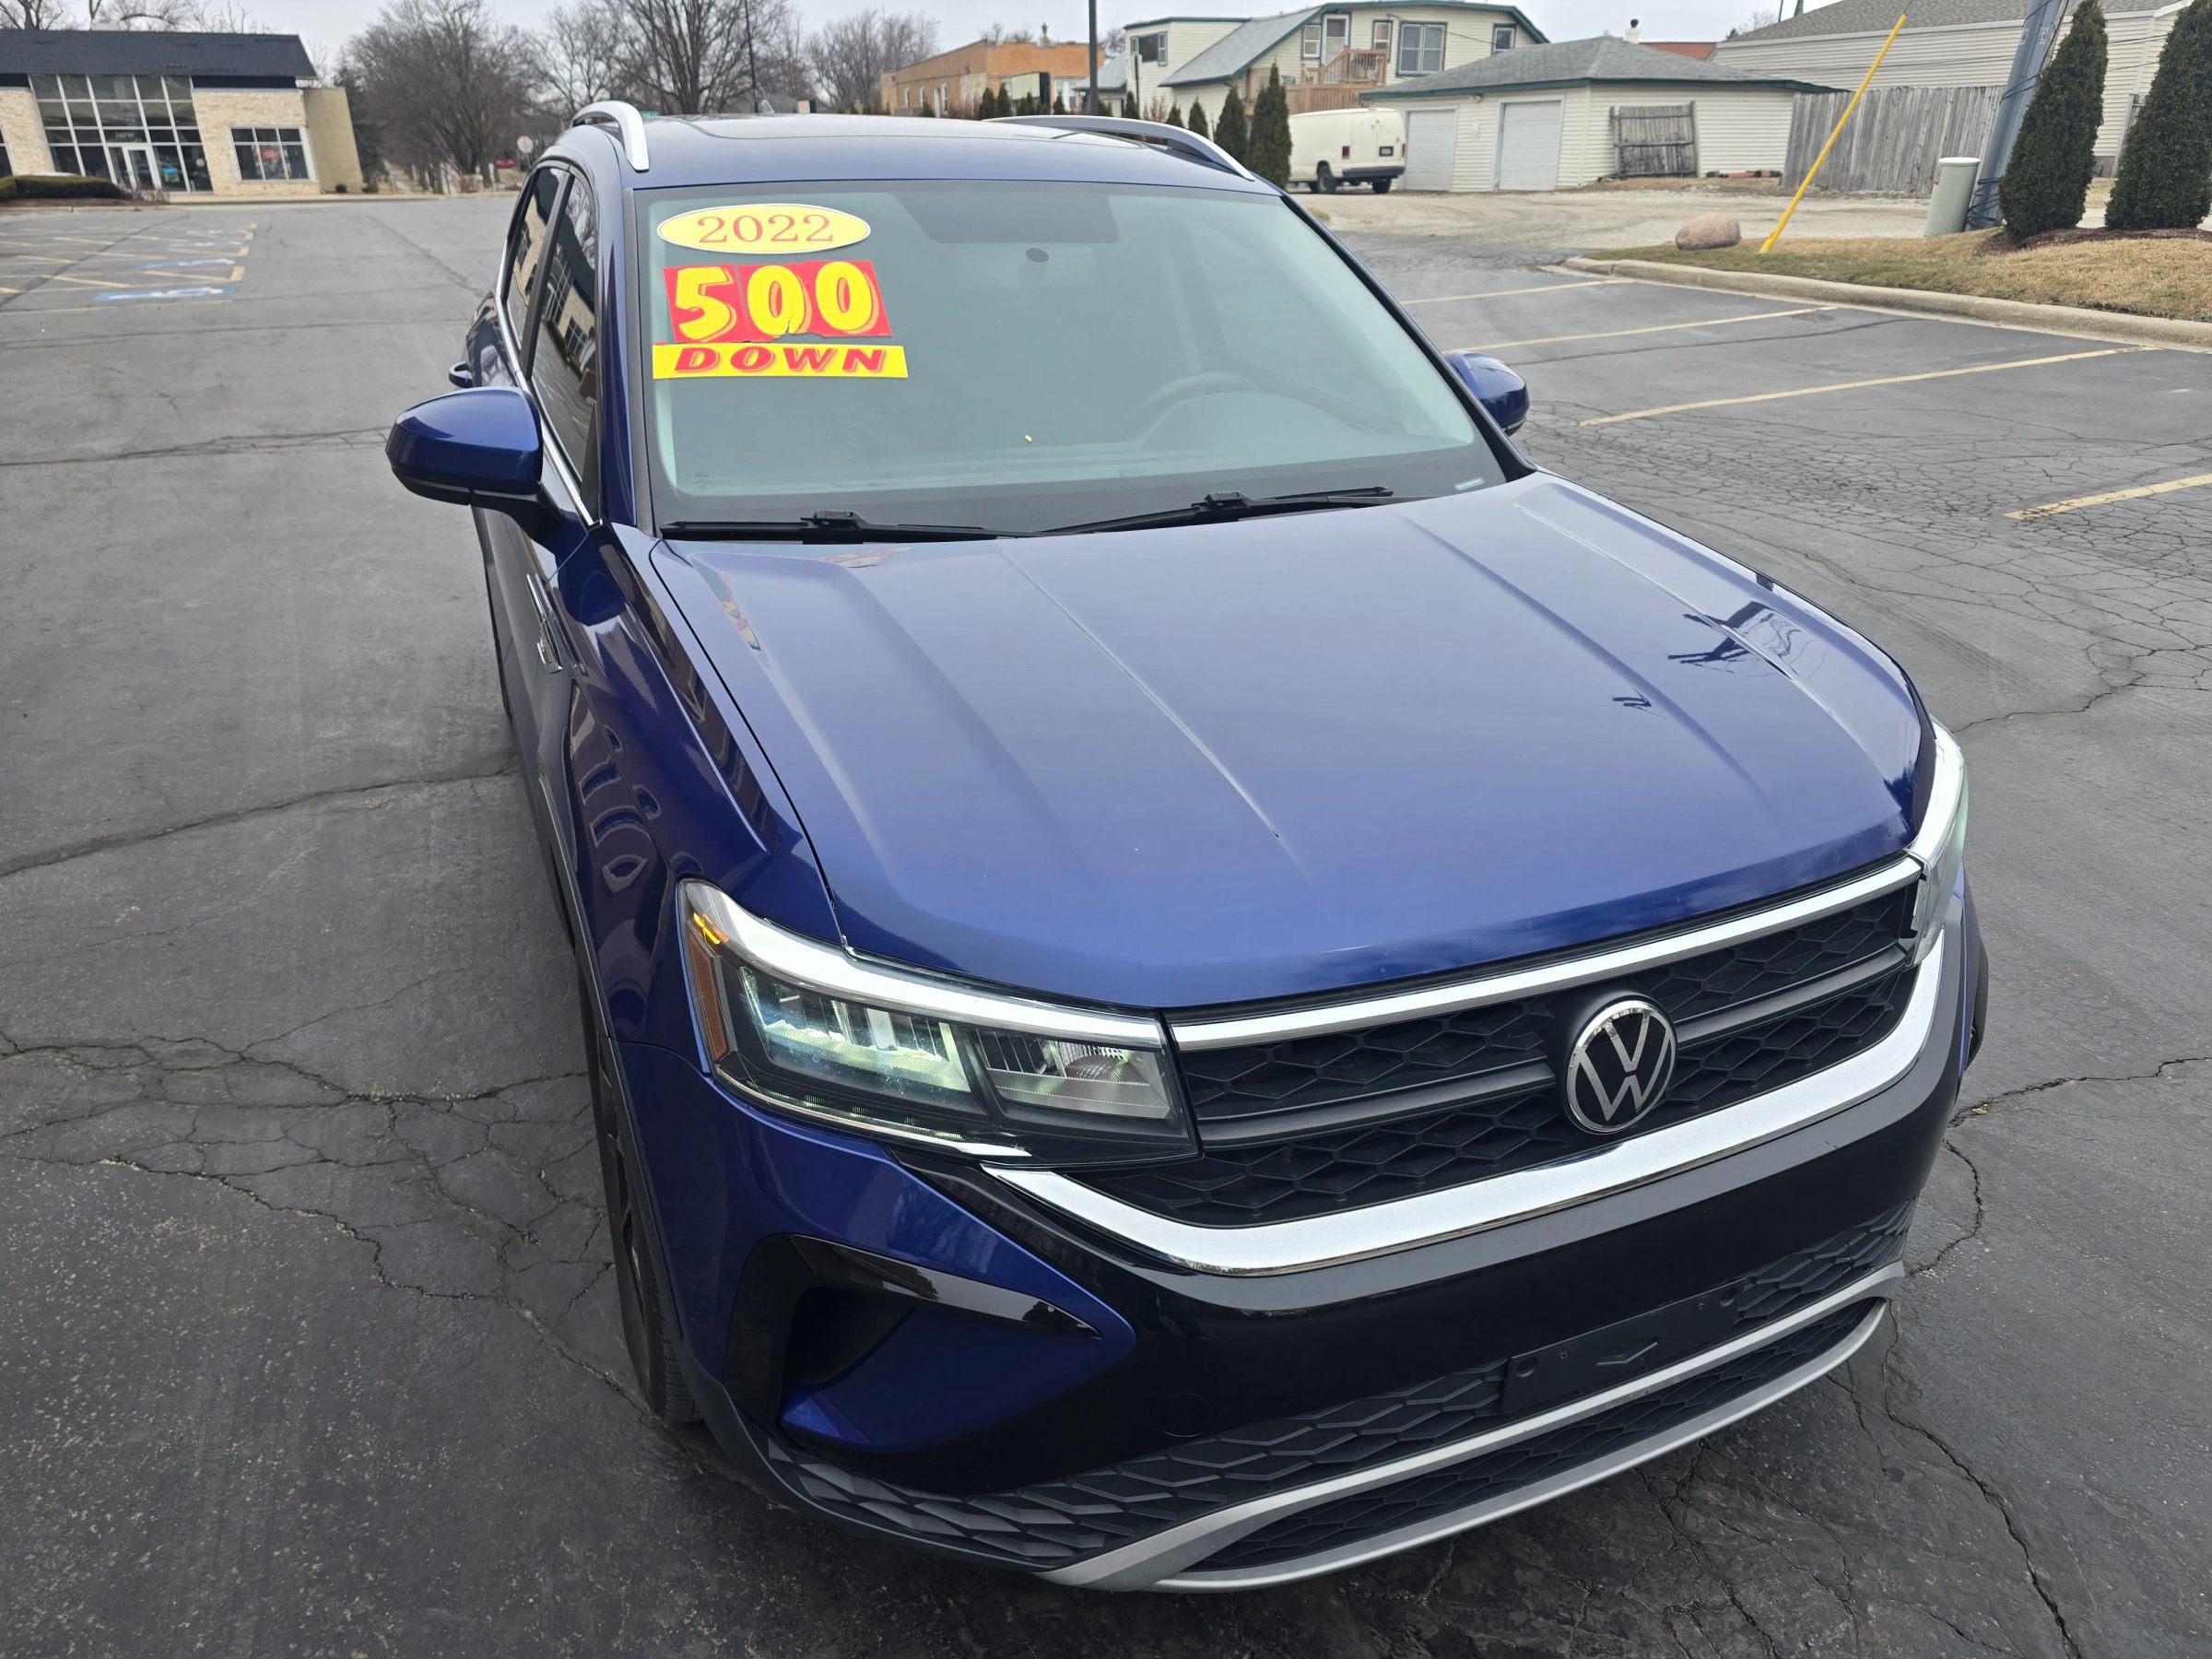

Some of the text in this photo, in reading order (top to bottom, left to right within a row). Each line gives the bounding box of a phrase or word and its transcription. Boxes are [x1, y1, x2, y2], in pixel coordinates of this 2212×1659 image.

[697, 214, 834, 243] 2022
[676, 261, 879, 342] 500
[675, 346, 886, 373] DOWN
[1571, 1006, 1672, 1123] VW
